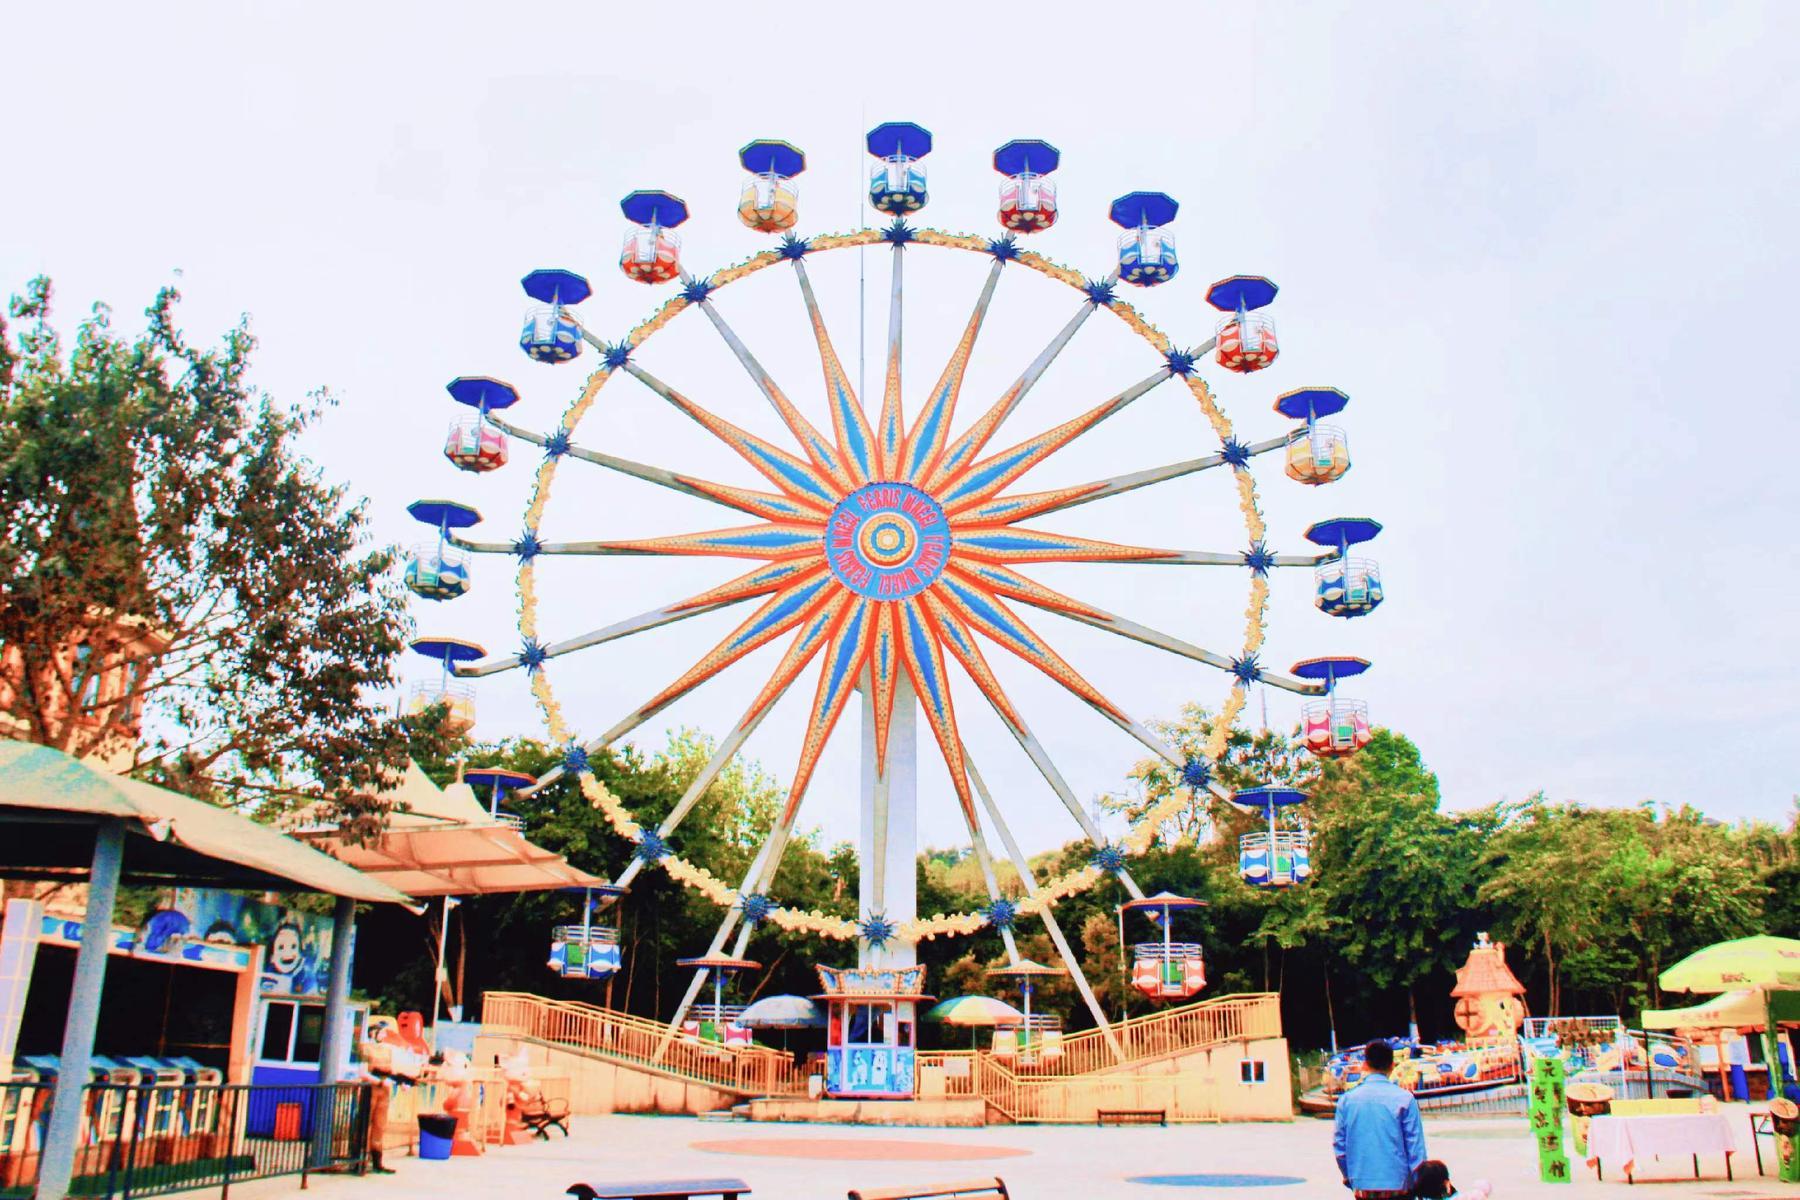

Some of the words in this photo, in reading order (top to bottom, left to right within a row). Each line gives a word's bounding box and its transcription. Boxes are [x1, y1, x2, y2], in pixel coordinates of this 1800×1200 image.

[832, 509, 862, 548] WHEEL
[857, 488, 902, 512] FERRIS
[902, 493, 939, 530] WHEEL
[834, 550, 873, 589] FERRIS
[879, 568, 921, 595] WHEEL
